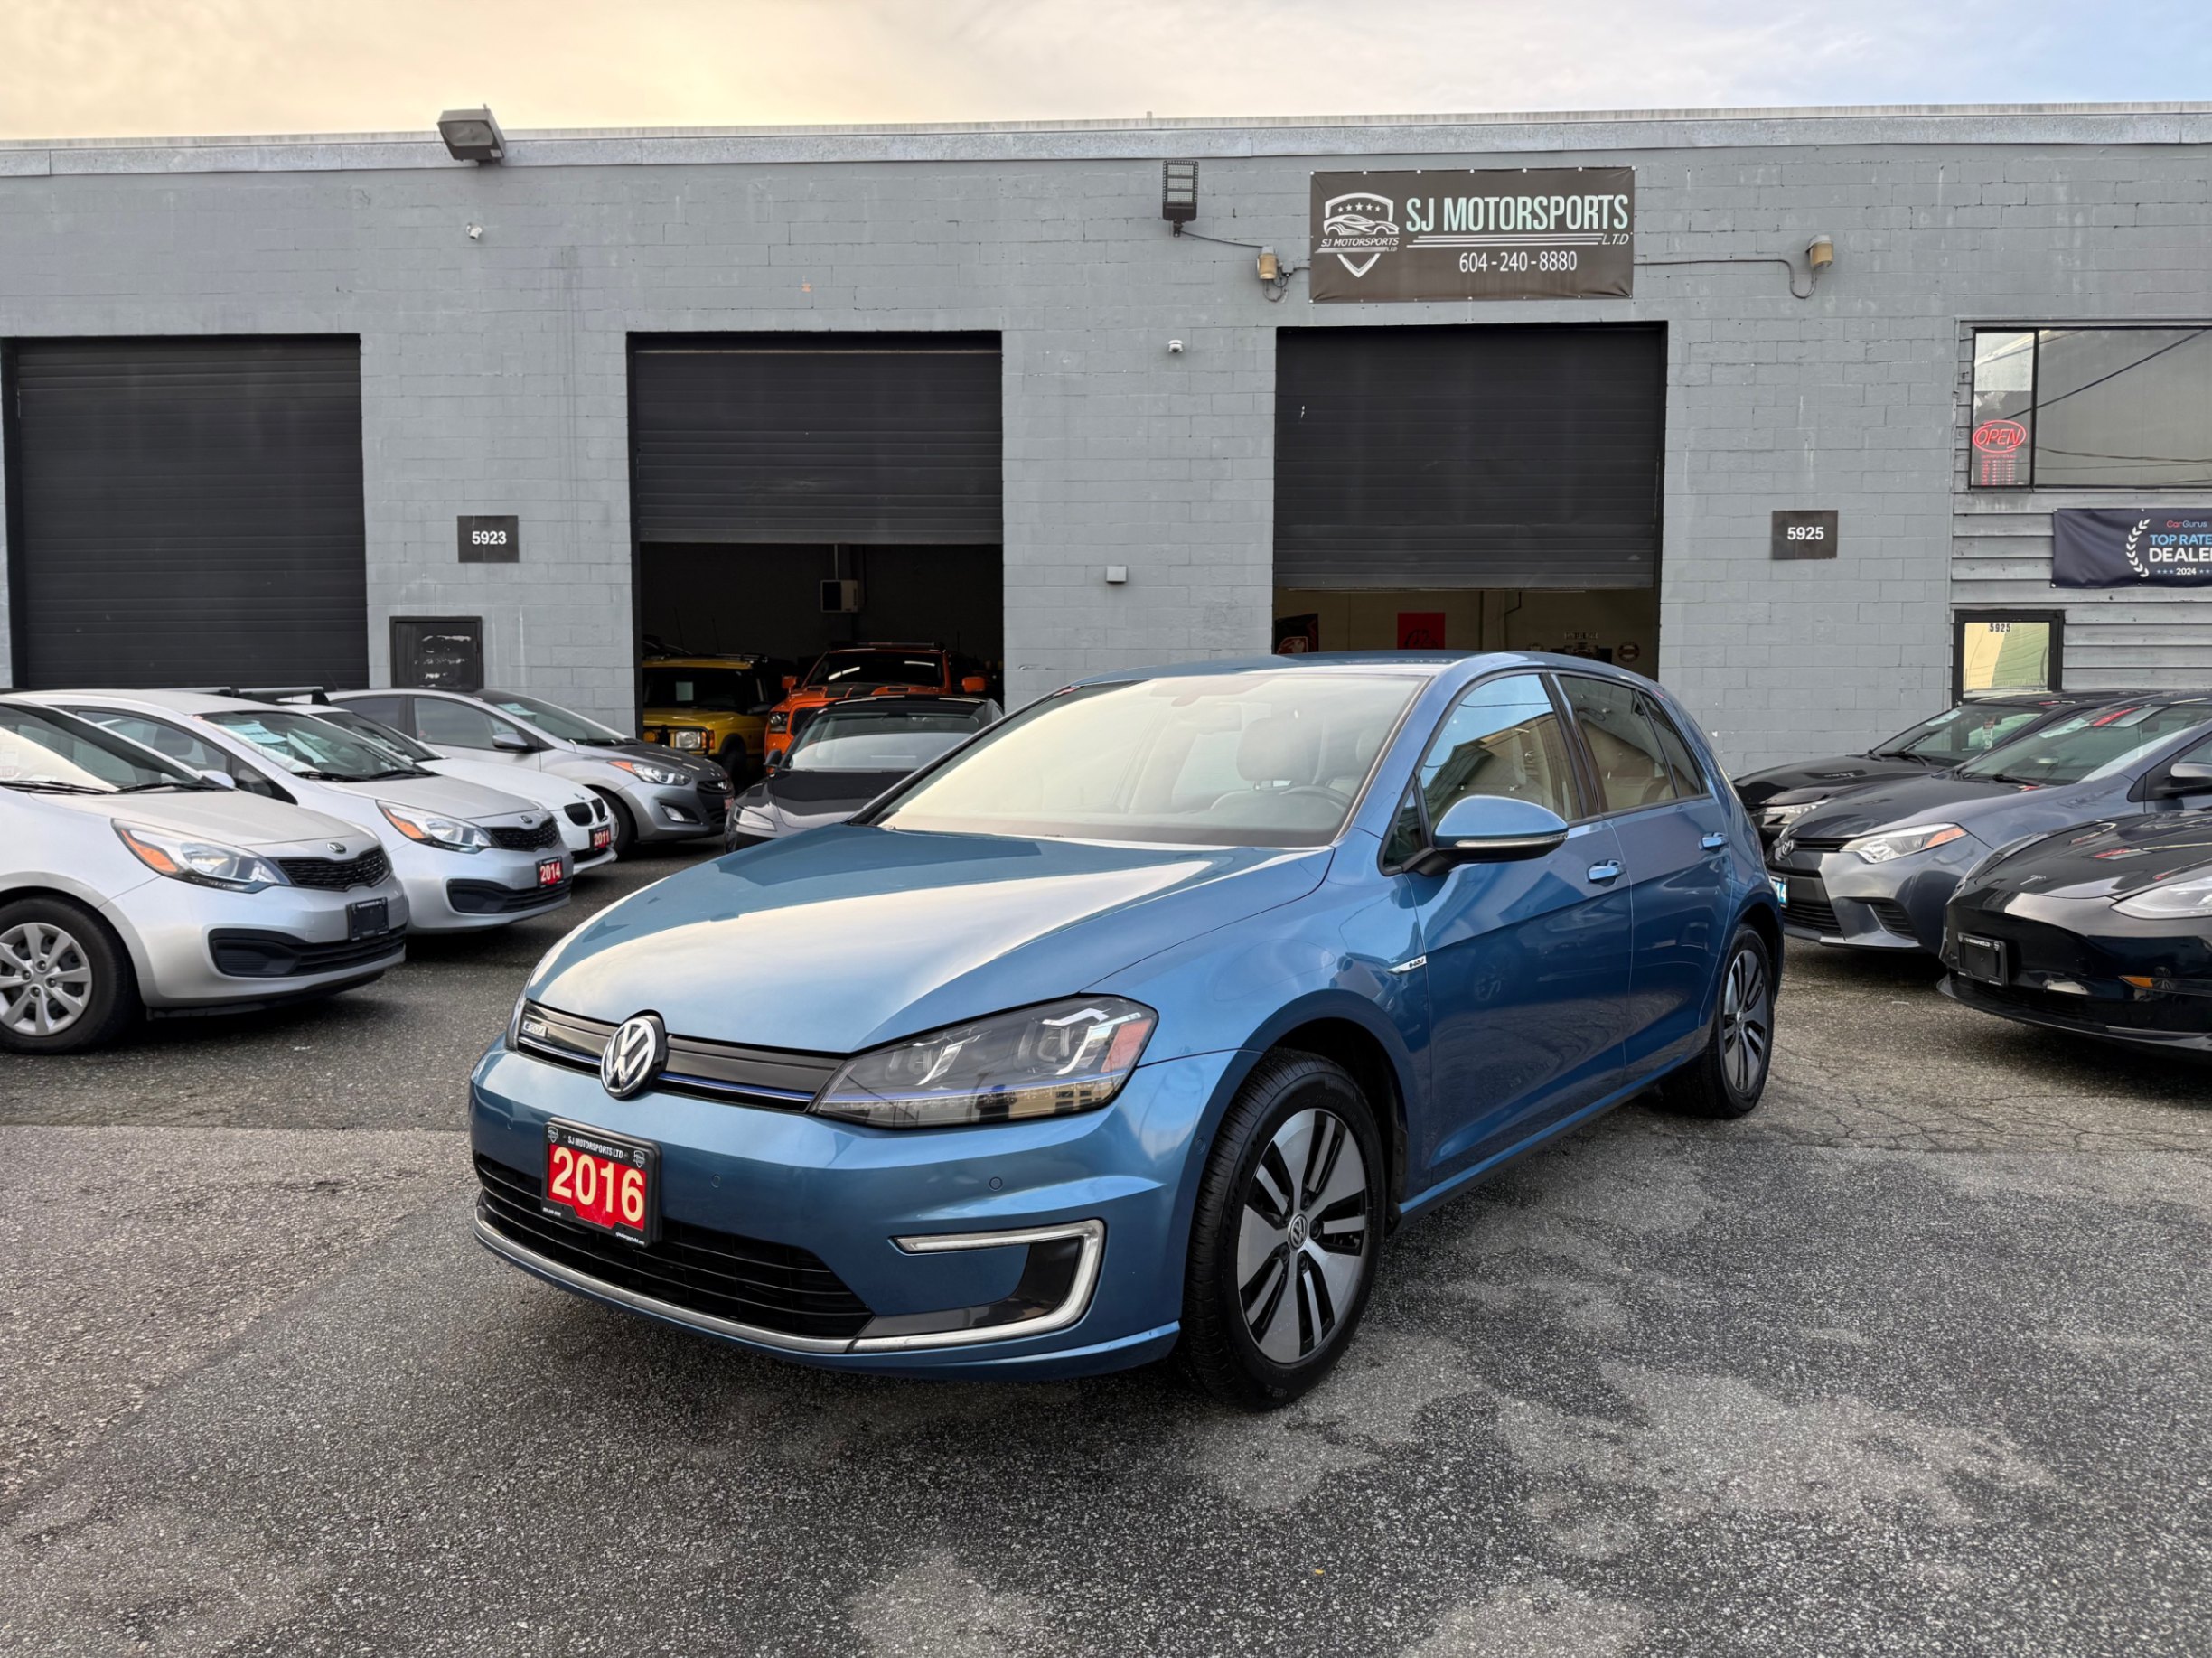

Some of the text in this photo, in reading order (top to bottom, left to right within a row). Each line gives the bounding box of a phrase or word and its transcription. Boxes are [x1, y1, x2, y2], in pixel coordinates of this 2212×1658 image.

[1406, 194, 1628, 231] SJ MOTORSPORTS
[1321, 237, 1400, 247] SJ MOTORSPORTS
[1976, 428, 2021, 445] OPEN
[2166, 520, 2207, 528] CarGurus
[472, 531, 507, 545] 5923
[1787, 526, 1824, 540] 5925
[2150, 534, 2177, 546] TOP
[2149, 547, 2212, 563] DEALE
[2176, 567, 2197, 576] 2024
[1989, 623, 2011, 632] 5925
[594, 829, 610, 847] 2011
[539, 862, 561, 883] 2014
[567, 1136, 575, 1145] SJ
[614, 1149, 623, 1158] LTD
[552, 1147, 644, 1222] 2016
